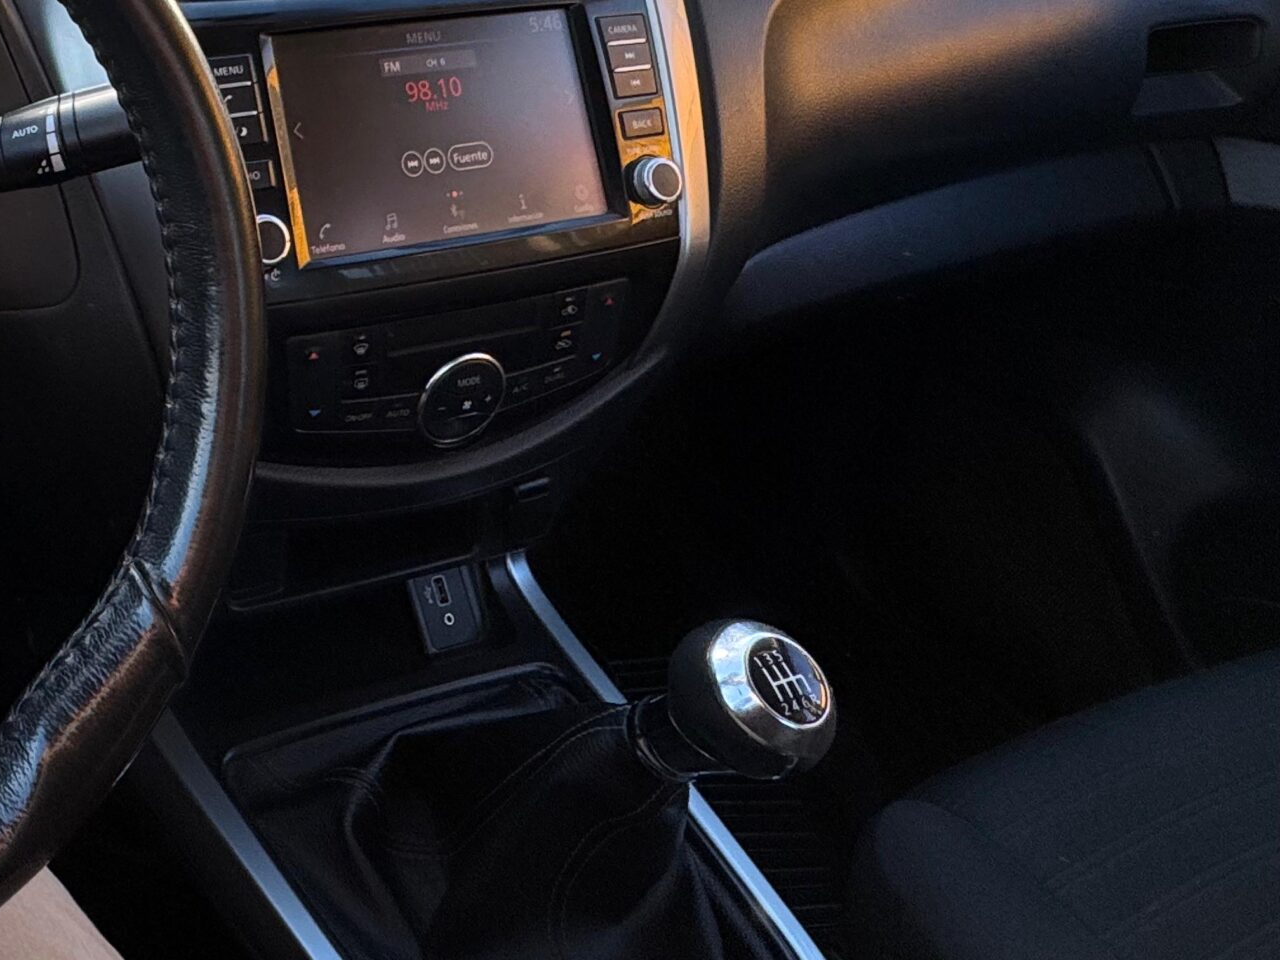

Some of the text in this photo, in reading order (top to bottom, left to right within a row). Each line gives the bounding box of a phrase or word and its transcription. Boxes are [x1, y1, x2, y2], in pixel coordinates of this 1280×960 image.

[406, 30, 441, 45] MENU
[214, 64, 244, 78] MENU
[383, 61, 401, 74] FM
[426, 59, 438, 68] CH
[405, 76, 463, 102] 98.10
[425, 100, 449, 113] MHz
[11, 125, 39, 140] AUTO
[453, 149, 489, 165] Fuente
[382, 232, 407, 244] Audio
[456, 374, 482, 388] MODE
[385, 407, 410, 419] AUTO
[753, 649, 784, 668] 1 3 5
[780, 702, 792, 716] 2
[792, 698, 801, 711] 4
[801, 695, 811, 709] 6
